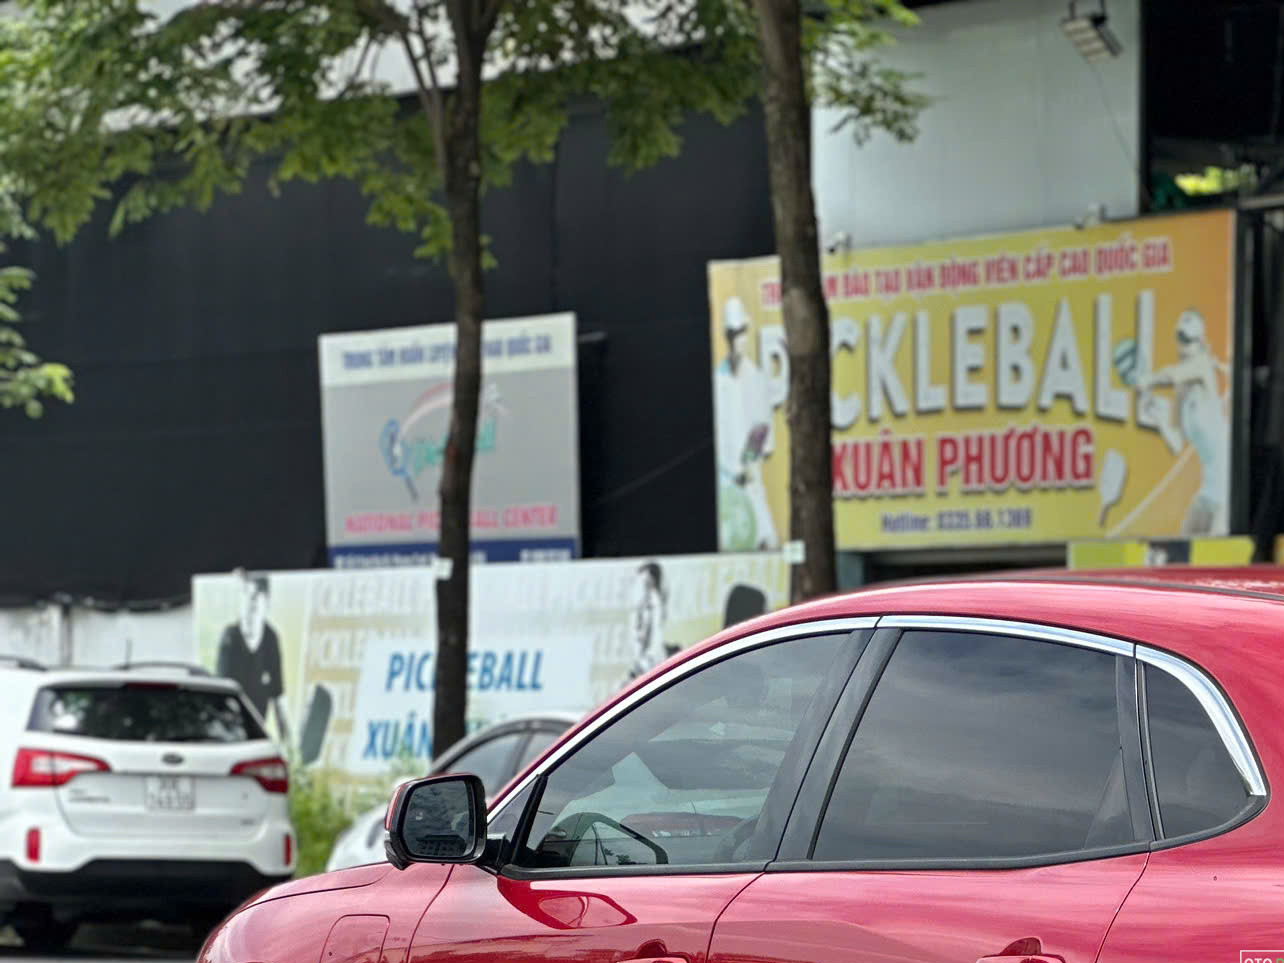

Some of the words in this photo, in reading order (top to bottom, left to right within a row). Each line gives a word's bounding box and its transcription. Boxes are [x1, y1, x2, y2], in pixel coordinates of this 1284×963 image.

[758, 289, 1174, 432] PCKLEBALL
[937, 427, 1095, 490] PHƯƠNG
[385, 650, 543, 692] PICEBALL
